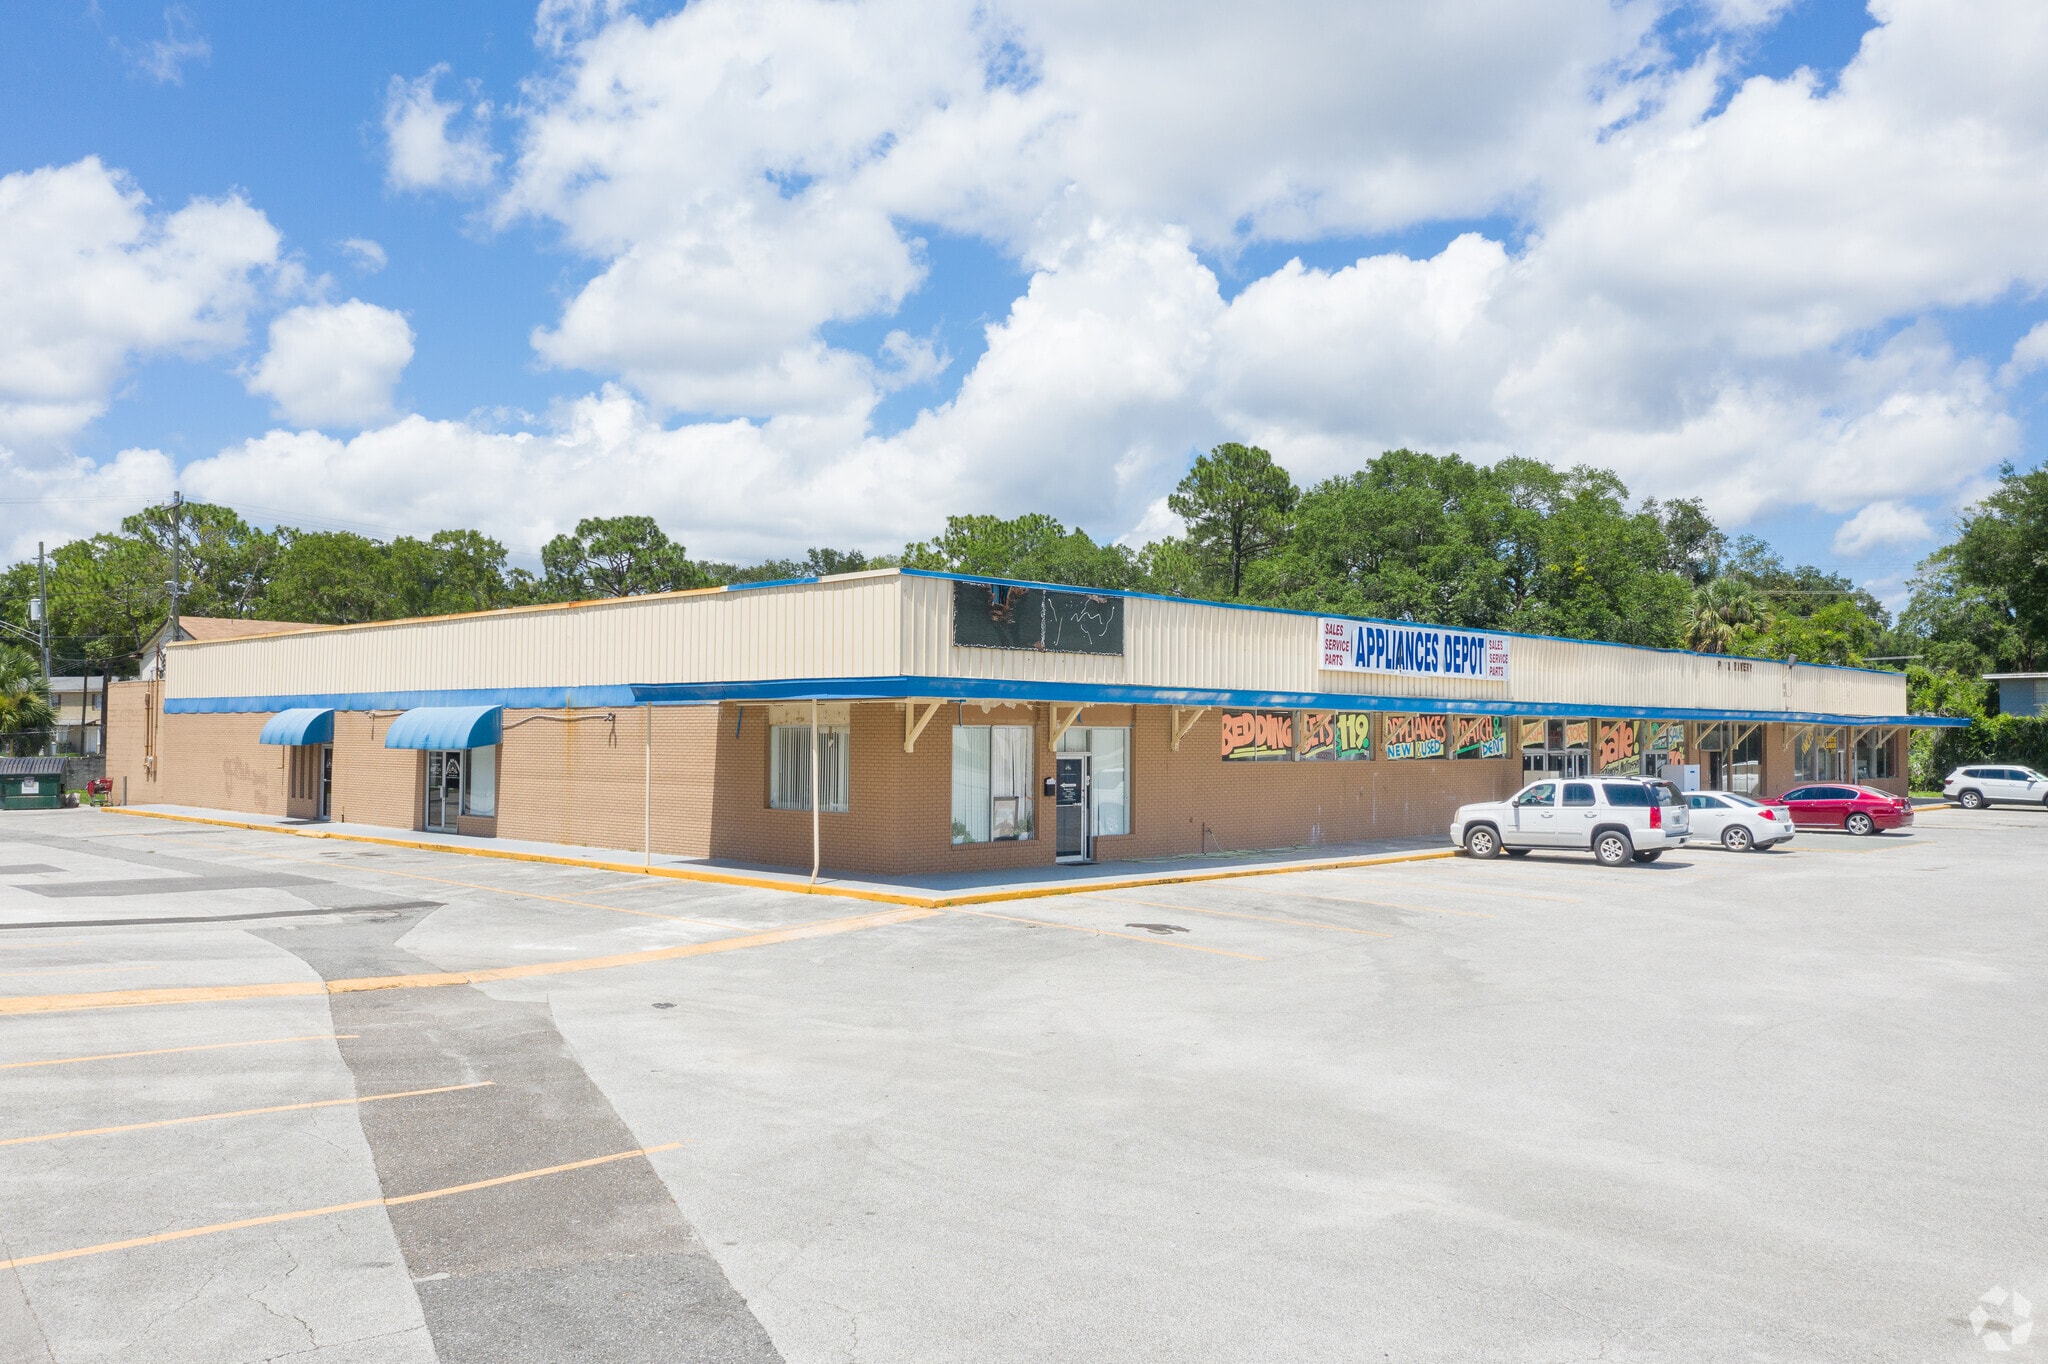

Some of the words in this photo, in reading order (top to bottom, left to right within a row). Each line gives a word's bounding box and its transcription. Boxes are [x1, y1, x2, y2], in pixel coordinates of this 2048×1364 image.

[1325, 623, 1344, 637] SALES
[1325, 639, 1349, 652] SERVICE
[1355, 626, 1439, 673] APPLIANCES
[1445, 634, 1485, 675] DEPOT
[1489, 640, 1503, 650] SALES
[1325, 654, 1343, 666] PARTS
[1489, 653, 1508, 664] SERVICE
[1489, 666, 1504, 676] PARTS
[1222, 712, 1293, 756] BEDDING
[1453, 716, 1493, 747] RATCH
[1387, 744, 1411, 759] NEW
[1482, 738, 1504, 756] DENT
